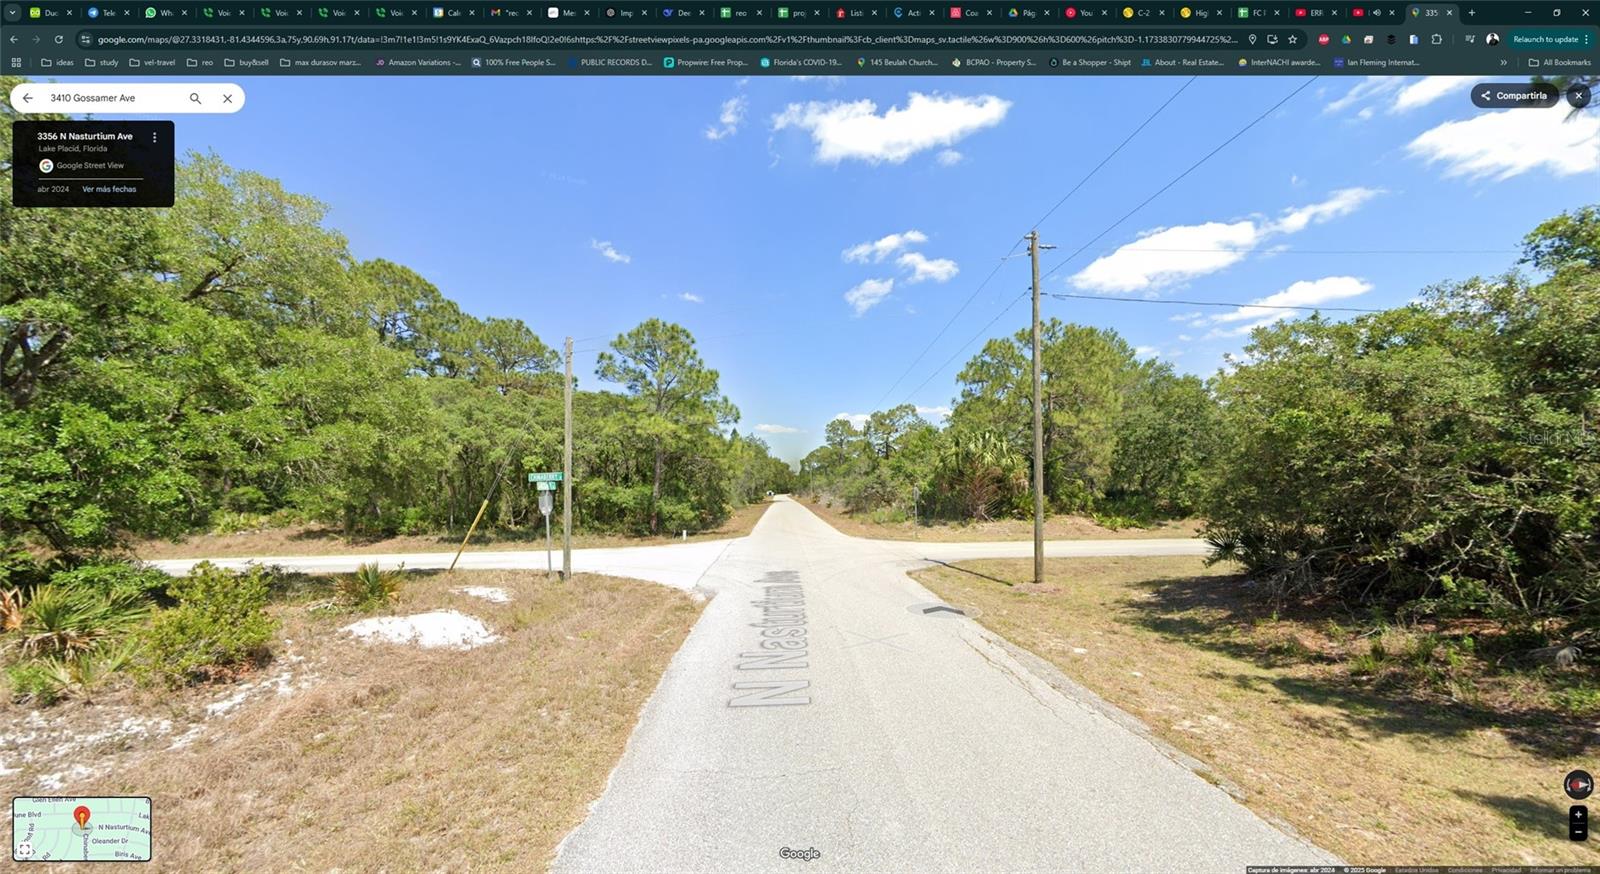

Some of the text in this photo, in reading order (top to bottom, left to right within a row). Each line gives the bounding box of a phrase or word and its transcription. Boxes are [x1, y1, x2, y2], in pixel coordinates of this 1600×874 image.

[1555, 36, 1578, 44] update
[100, 59, 119, 67] study
[144, 58, 175, 66] vel-travel
[240, 59, 269, 67] buy&sell
[522, 59, 544, 67] People
[678, 59, 709, 67] Propwire:
[996, 59, 1025, 67] Property
[1079, 59, 1107, 68] Shopper
[1114, 59, 1131, 67] Shipt
[1251, 58, 1289, 66] InterNACHI
[1360, 59, 1386, 68] Fleming
[51, 94, 135, 102] 3410 Gossamer Ave
[1497, 92, 1547, 101] Compartirla
[37, 132, 58, 140] 3356
[69, 132, 115, 140] Nasturtium
[57, 162, 83, 170] Google
[728, 680, 811, 707] N
[105, 824, 140, 832] Nasturtium
[130, 853, 142, 861] Ave
[779, 846, 821, 862] Google
